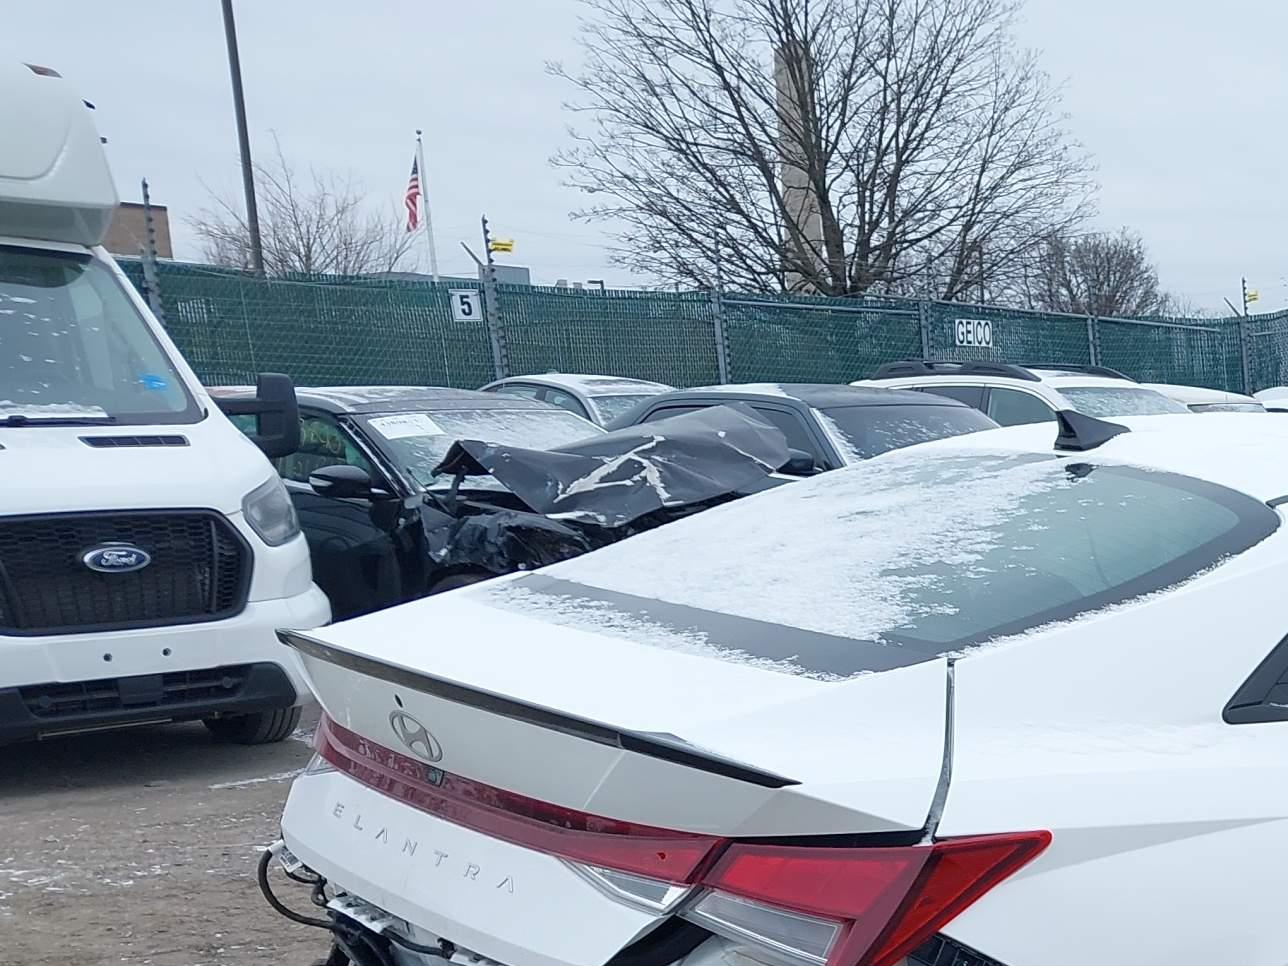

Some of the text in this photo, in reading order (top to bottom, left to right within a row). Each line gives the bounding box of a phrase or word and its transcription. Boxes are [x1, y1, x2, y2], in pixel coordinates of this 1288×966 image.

[459, 295, 473, 316] 5
[956, 320, 991, 346] GEICO
[333, 801, 516, 894] ELANTRA
